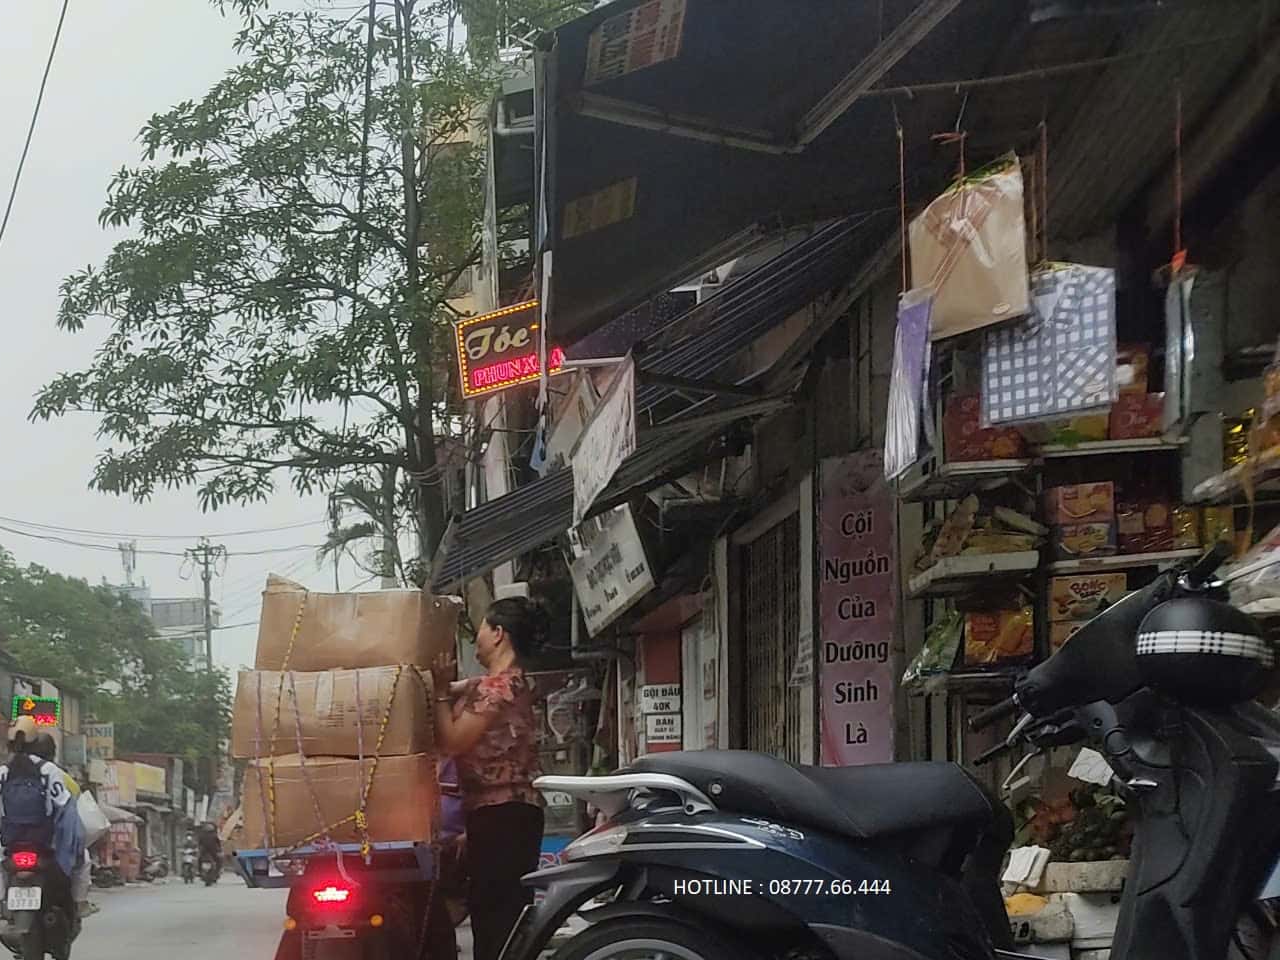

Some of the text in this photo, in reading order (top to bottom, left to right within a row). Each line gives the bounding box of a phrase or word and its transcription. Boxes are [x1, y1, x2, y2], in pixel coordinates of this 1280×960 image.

[474, 360, 521, 387] PHUN
[841, 511, 873, 541] Cội
[825, 551, 889, 585] Nguồn
[837, 596, 876, 621] Của
[825, 640, 889, 664] Dưỡng
[643, 687, 659, 699] GỘI
[835, 680, 878, 705] Sinh
[653, 702, 671, 711] 40K
[845, 722, 868, 745] Là
